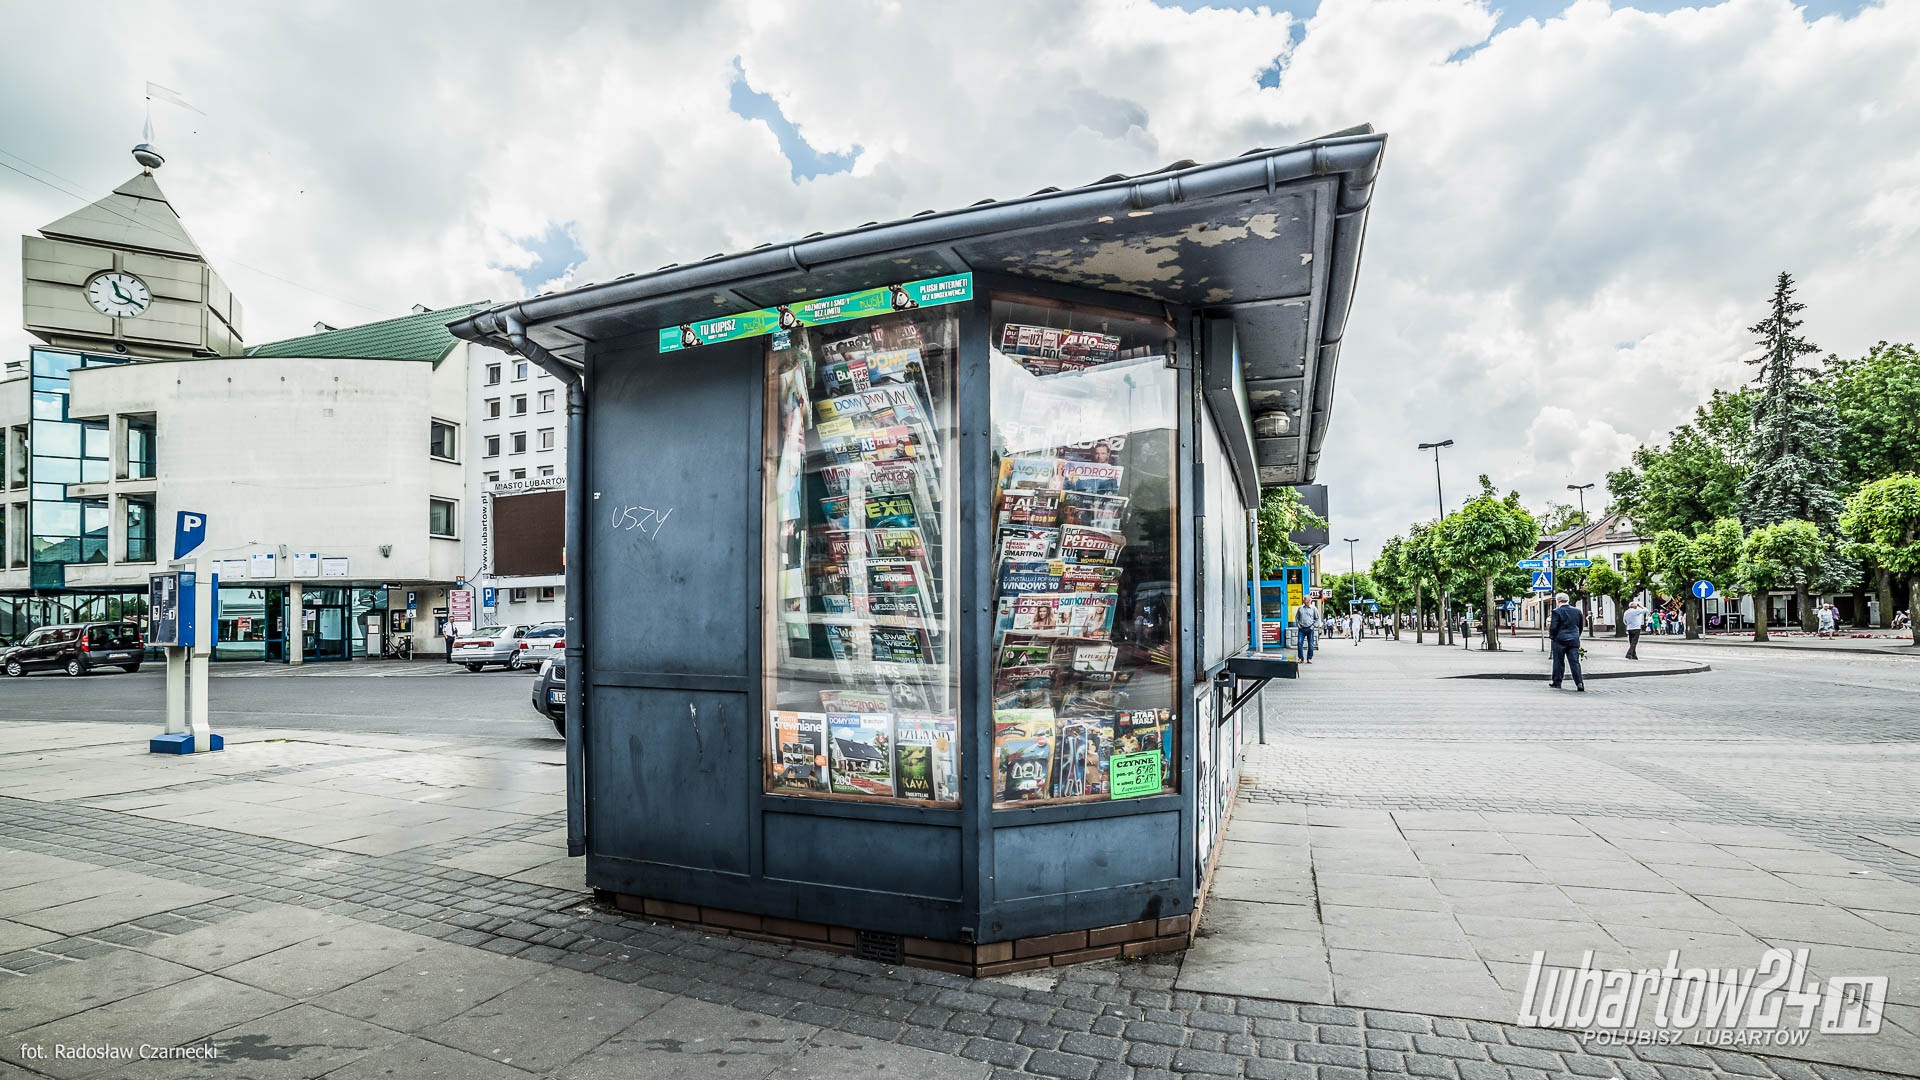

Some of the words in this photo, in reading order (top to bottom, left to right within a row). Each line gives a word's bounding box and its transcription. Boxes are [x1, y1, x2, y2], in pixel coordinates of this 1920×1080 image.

[804, 301, 830, 312] ROZMOWY
[700, 325, 709, 336] TU
[710, 319, 736, 334] KUPISZ
[866, 352, 908, 369] DOMY
[833, 397, 862, 411] DOMY
[494, 481, 523, 490] MIASTO
[184, 514, 202, 532] P
[612, 505, 673, 540] USZY
[1080, 536, 1119, 550] Format
[1004, 550, 1044, 558] SMARTFON
[1003, 582, 1046, 590] WINDOWS
[1049, 582, 1059, 590] 10
[408, 593, 414, 604] P
[485, 589, 492, 600] P
[774, 717, 822, 732] drewniane
[1116, 757, 1154, 768] CZYNNE
[834, 774, 851, 785] 200
[902, 777, 929, 790] KAVA
